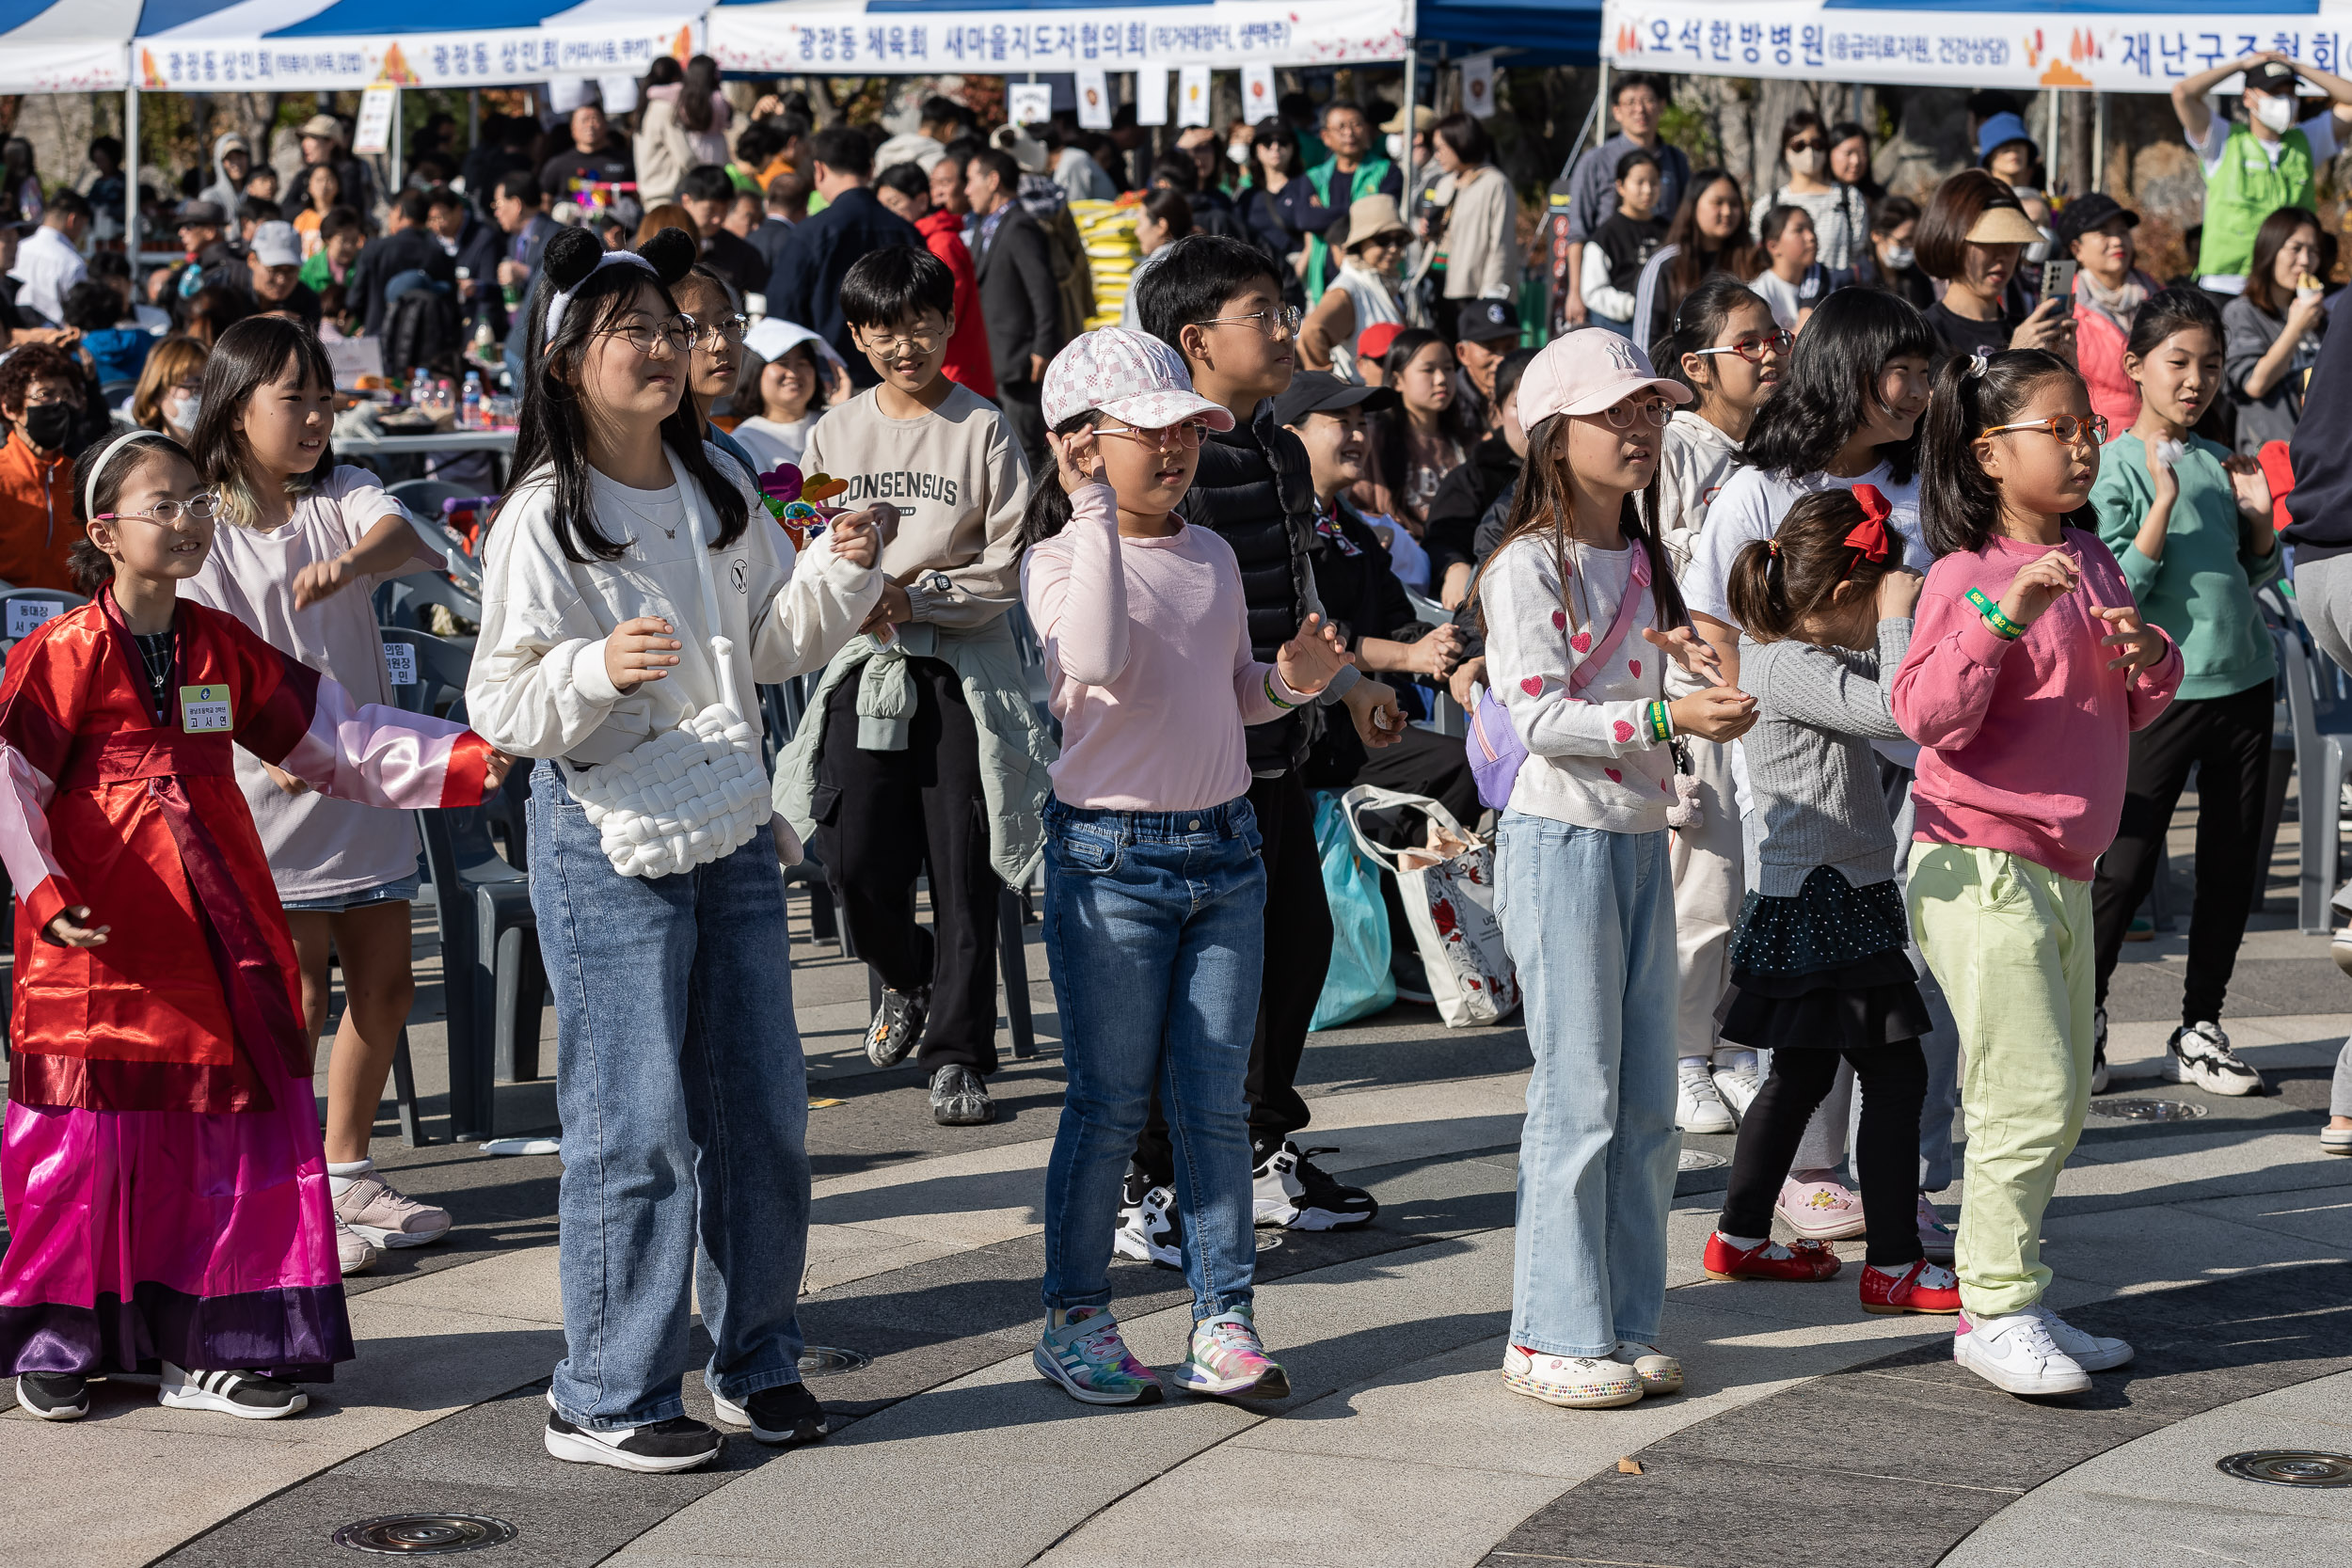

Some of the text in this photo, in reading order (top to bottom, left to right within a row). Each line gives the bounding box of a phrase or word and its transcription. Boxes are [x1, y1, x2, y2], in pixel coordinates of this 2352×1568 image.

[434, 41, 490, 75] 광장동
[501, 38, 559, 72] 상인회
[799, 26, 858, 62] 광장동
[866, 24, 929, 61] 체육회
[944, 23, 1147, 61] 새마을지도자협의회
[1649, 18, 1825, 67] 오석한방병원
[169, 51, 217, 81] 광장동
[222, 50, 273, 81] 상인회
[20, 605, 49, 617] 동대장
[1970, 592, 1984, 606] 582
[1991, 612, 2007, 628] 582
